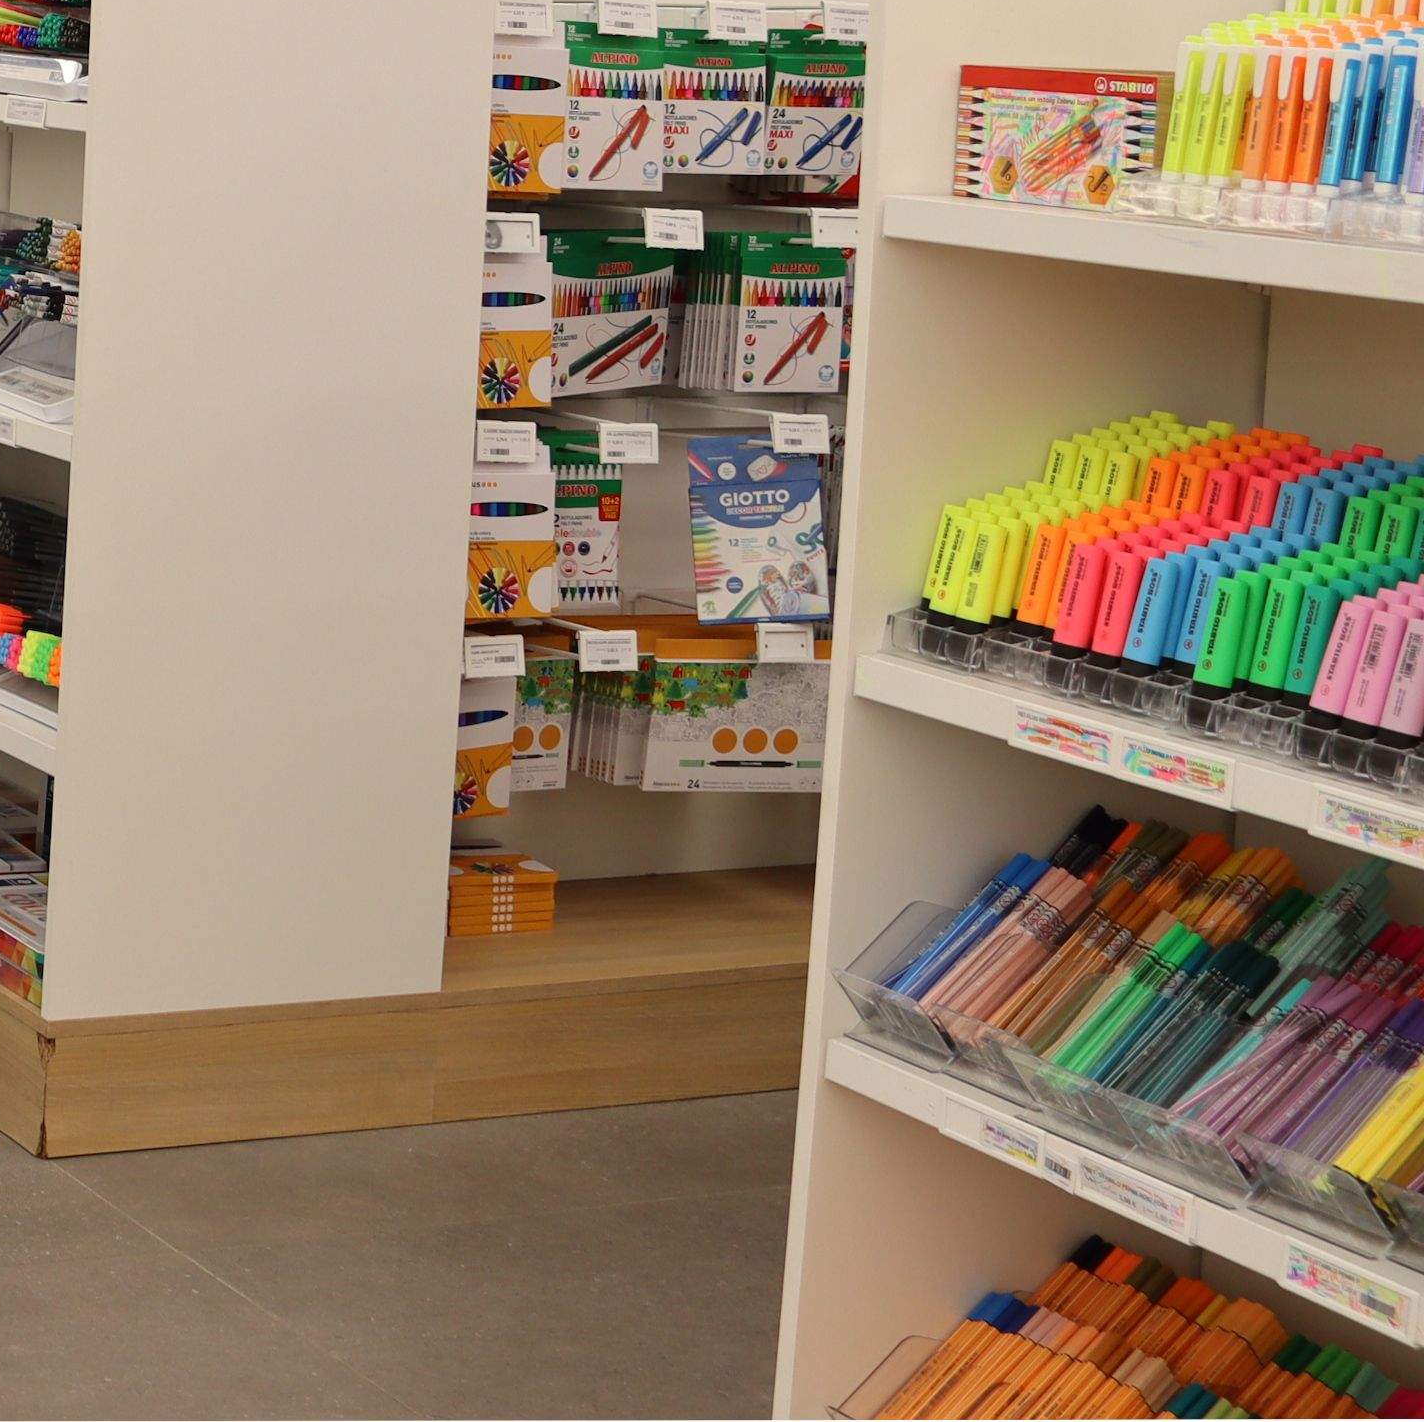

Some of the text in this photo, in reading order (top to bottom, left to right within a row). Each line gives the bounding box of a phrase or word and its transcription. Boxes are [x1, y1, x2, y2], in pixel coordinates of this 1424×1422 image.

[592, 52, 640, 66] ALPINO
[695, 57, 733, 67] ALPINO
[804, 63, 848, 75] ALPINO
[1108, 81, 1155, 94] STABILO
[569, 100, 579, 110] 12
[664, 104, 676, 115] 12
[772, 108, 786, 119] 24
[663, 126, 689, 135] MAXI
[769, 130, 794, 139] MAXI
[769, 263, 821, 275] ALPINO
[746, 309, 757, 319] 12
[553, 322, 565, 334] 24
[719, 489, 790, 507] GIOTTO
[727, 538, 740, 547] 12
[1137, 571, 1158, 634] STABILO BOSS
[1206, 591, 1226, 656] STABILO BOSS
[1262, 590, 1281, 656] STABILO BOSS
[1325, 615, 1351, 681] STABILO BOSS
